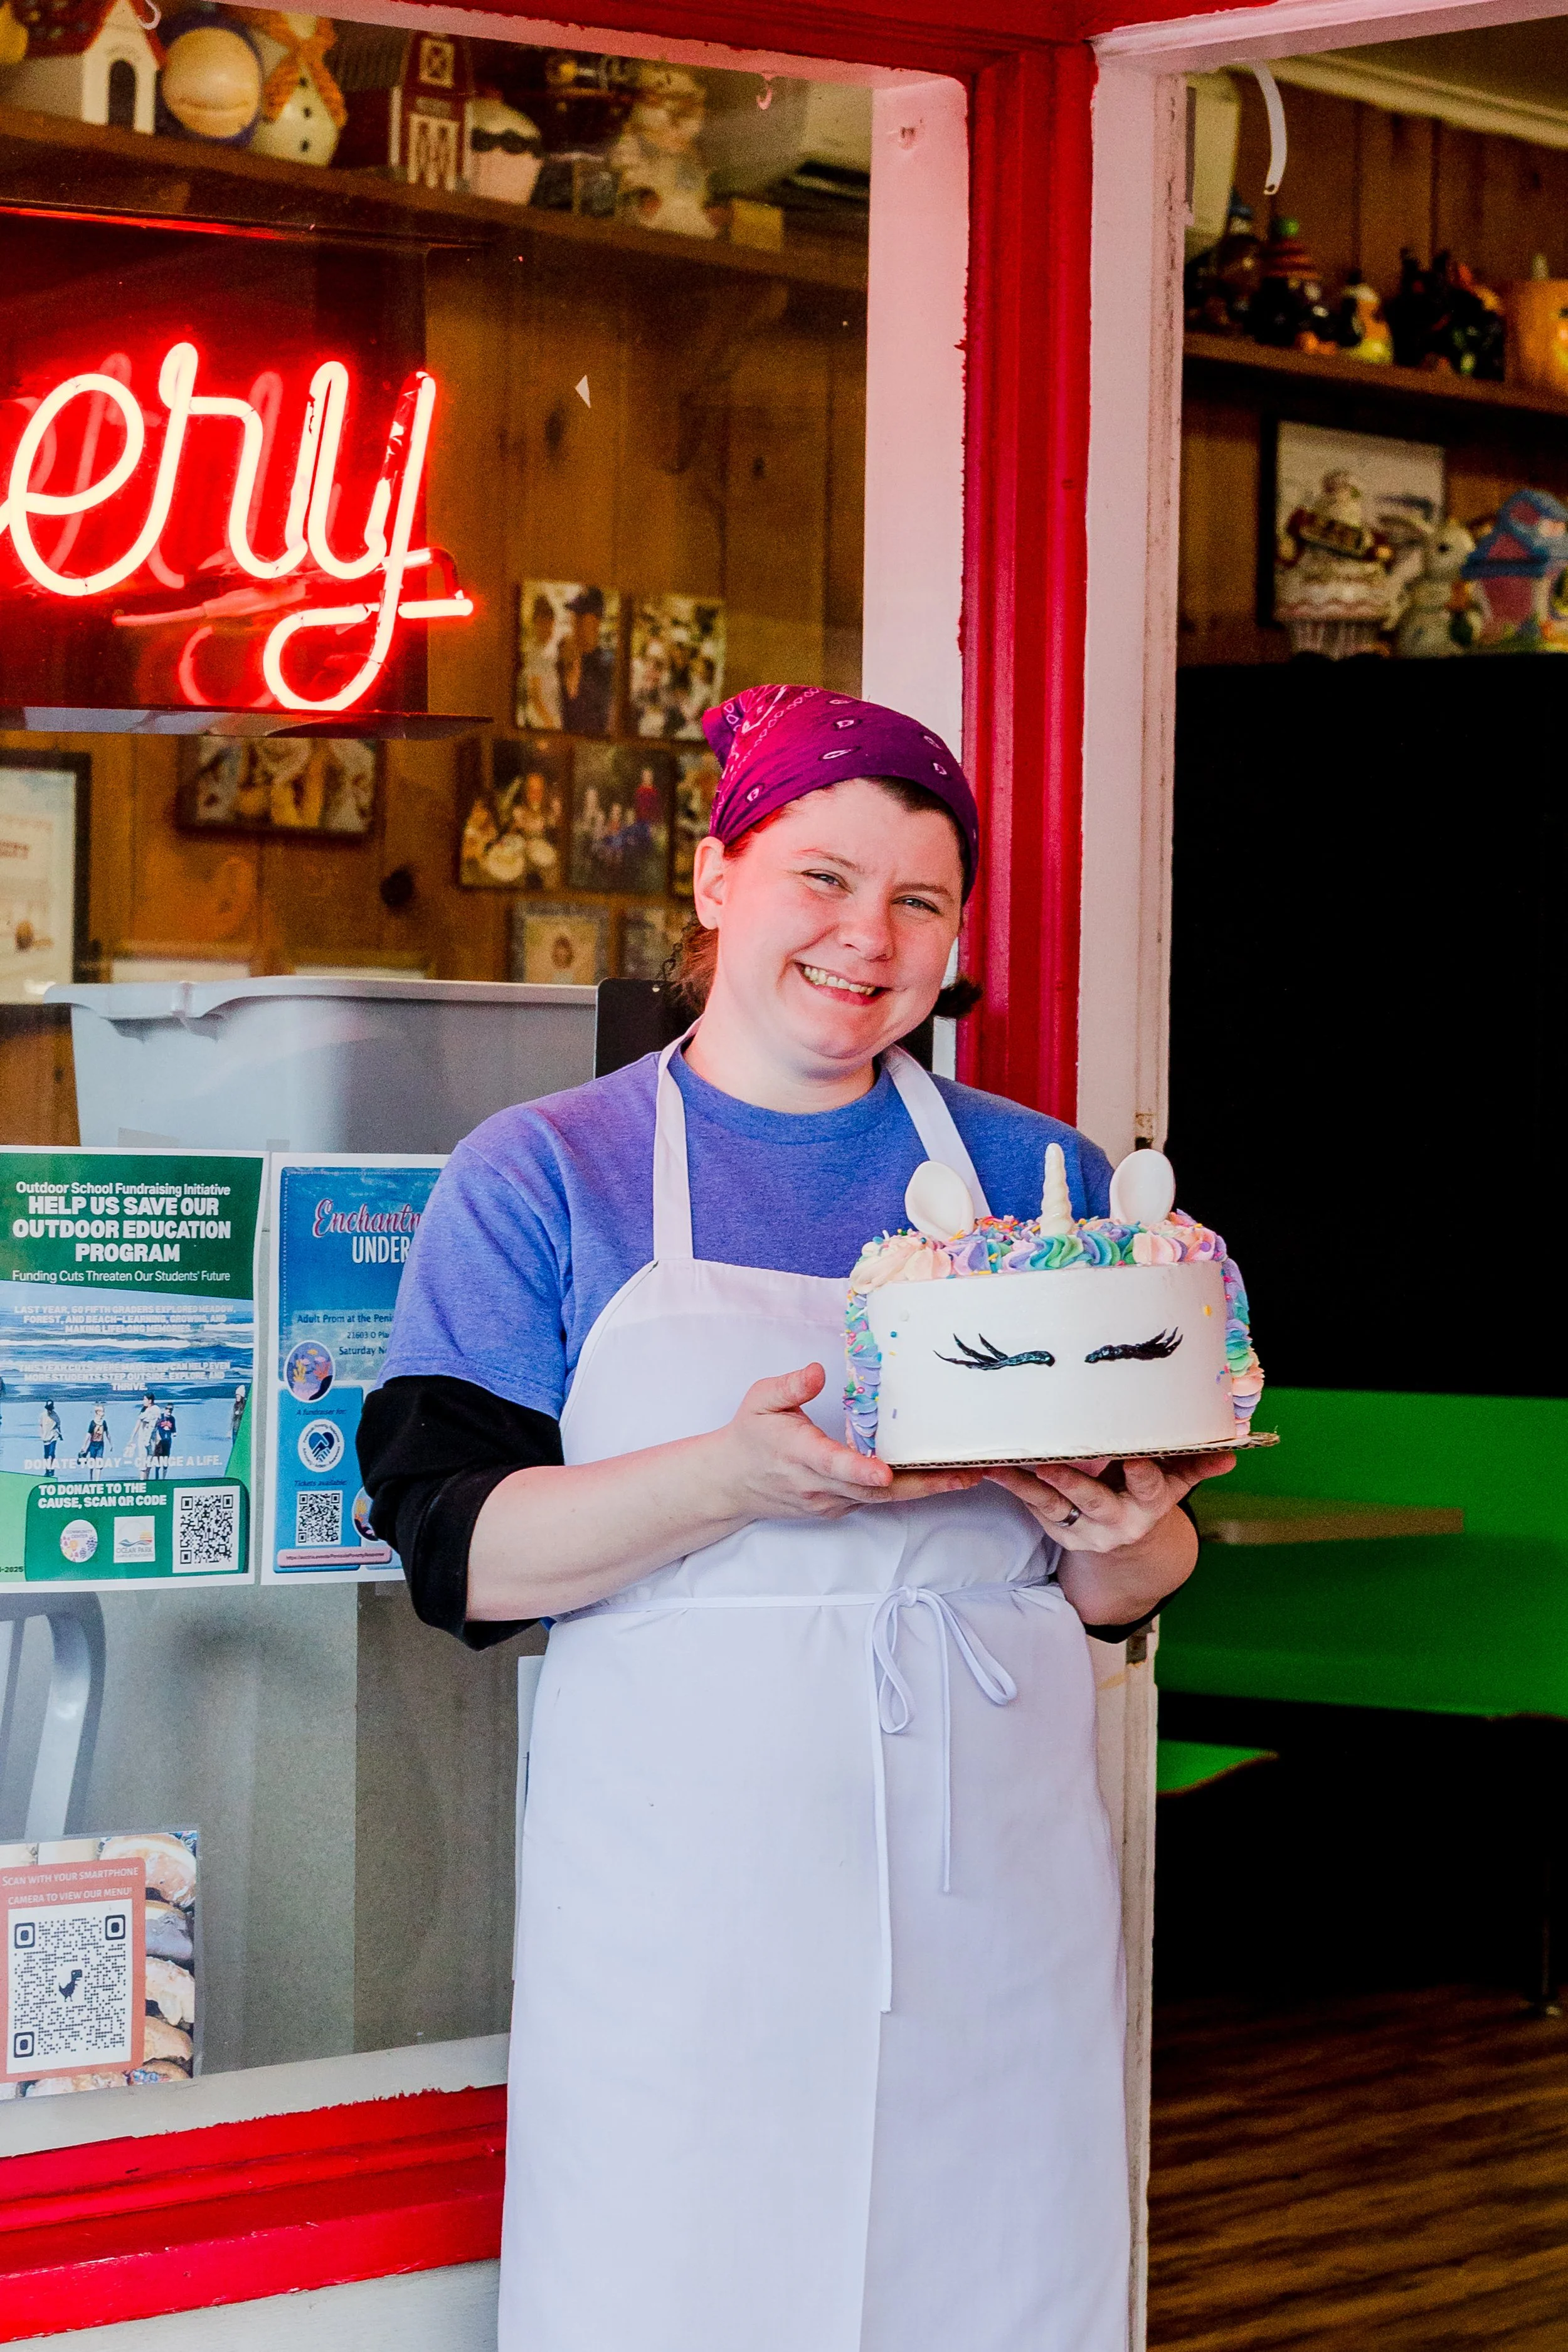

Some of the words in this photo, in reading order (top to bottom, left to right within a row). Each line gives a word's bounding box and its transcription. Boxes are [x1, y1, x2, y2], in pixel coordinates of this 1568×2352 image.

[16, 1181, 70, 1194] Outdoor
[71, 1182, 113, 1194] School
[115, 1182, 182, 1198] Fundraising
[184, 1183, 231, 1195] Initiative
[28, 1195, 87, 1215] HELP
[90, 1196, 120, 1216] US
[123, 1196, 178, 1216] SAVE
[180, 1197, 220, 1216] OUR
[13, 1219, 120, 1239] OUTDOOR
[122, 1220, 231, 1239] EDUCATION
[75, 1243, 181, 1263] PROGRAM
[12, 1269, 57, 1284] Funding
[59, 1270, 85, 1282] Cuts
[85, 1270, 132, 1282] Threaten
[134, 1270, 154, 1282] Our
[154, 1270, 200, 1282] Students'
[201, 1270, 231, 1281] Future
[14, 1305, 40, 1314] LAST
[40, 1305, 71, 1315] YEAR,
[85, 1305, 111, 1313] FIFTH
[112, 1305, 154, 1313] GRADERS
[23, 1315, 65, 1324] FOREST,
[65, 1315, 85, 1323] AND
[209, 1315, 227, 1323] AND
[297, 1315, 320, 1323] Adult
[322, 1314, 345, 1323] Prom
[347, 1315, 355, 1323] at
[358, 1314, 371, 1323] the
[65, 1325, 101, 1333] MAKING
[347, 1331, 369, 1339] 21603
[339, 1346, 375, 1357] Saturday
[169, 1362, 188, 1370] CAN
[209, 1362, 230, 1370] EVEN
[24, 1374, 51, 1382] MORE
[51, 1374, 102, 1382] STUDENTS
[102, 1373, 125, 1381] STEP
[208, 1371, 225, 1379] AND
[111, 1382, 148, 1391] THRIVE.
[24, 1458, 77, 1470] DONATE
[78, 1457, 122, 1469] TODAY
[134, 1456, 184, 1468] CHANGE
[186, 1456, 194, 1466] A
[196, 1454, 223, 1466] LIFE.
[38, 1485, 56, 1496] TO
[57, 1483, 104, 1495] DONATE
[105, 1483, 122, 1494] TO
[123, 1482, 147, 1493] THE
[38, 1496, 82, 1509] CAUSE,
[83, 1496, 117, 1508] SCAN
[117, 1496, 134, 1507] QR
[135, 1495, 167, 1506] CODE
[28, 1875, 51, 1884] WITH
[53, 1872, 78, 1882] YOUR
[79, 1867, 139, 1880] SMARTPHONE
[8, 1894, 44, 1905] CAMERA
[46, 1893, 58, 1902] TO
[59, 1890, 82, 1901] VIEW
[83, 1889, 102, 1899] OUR
